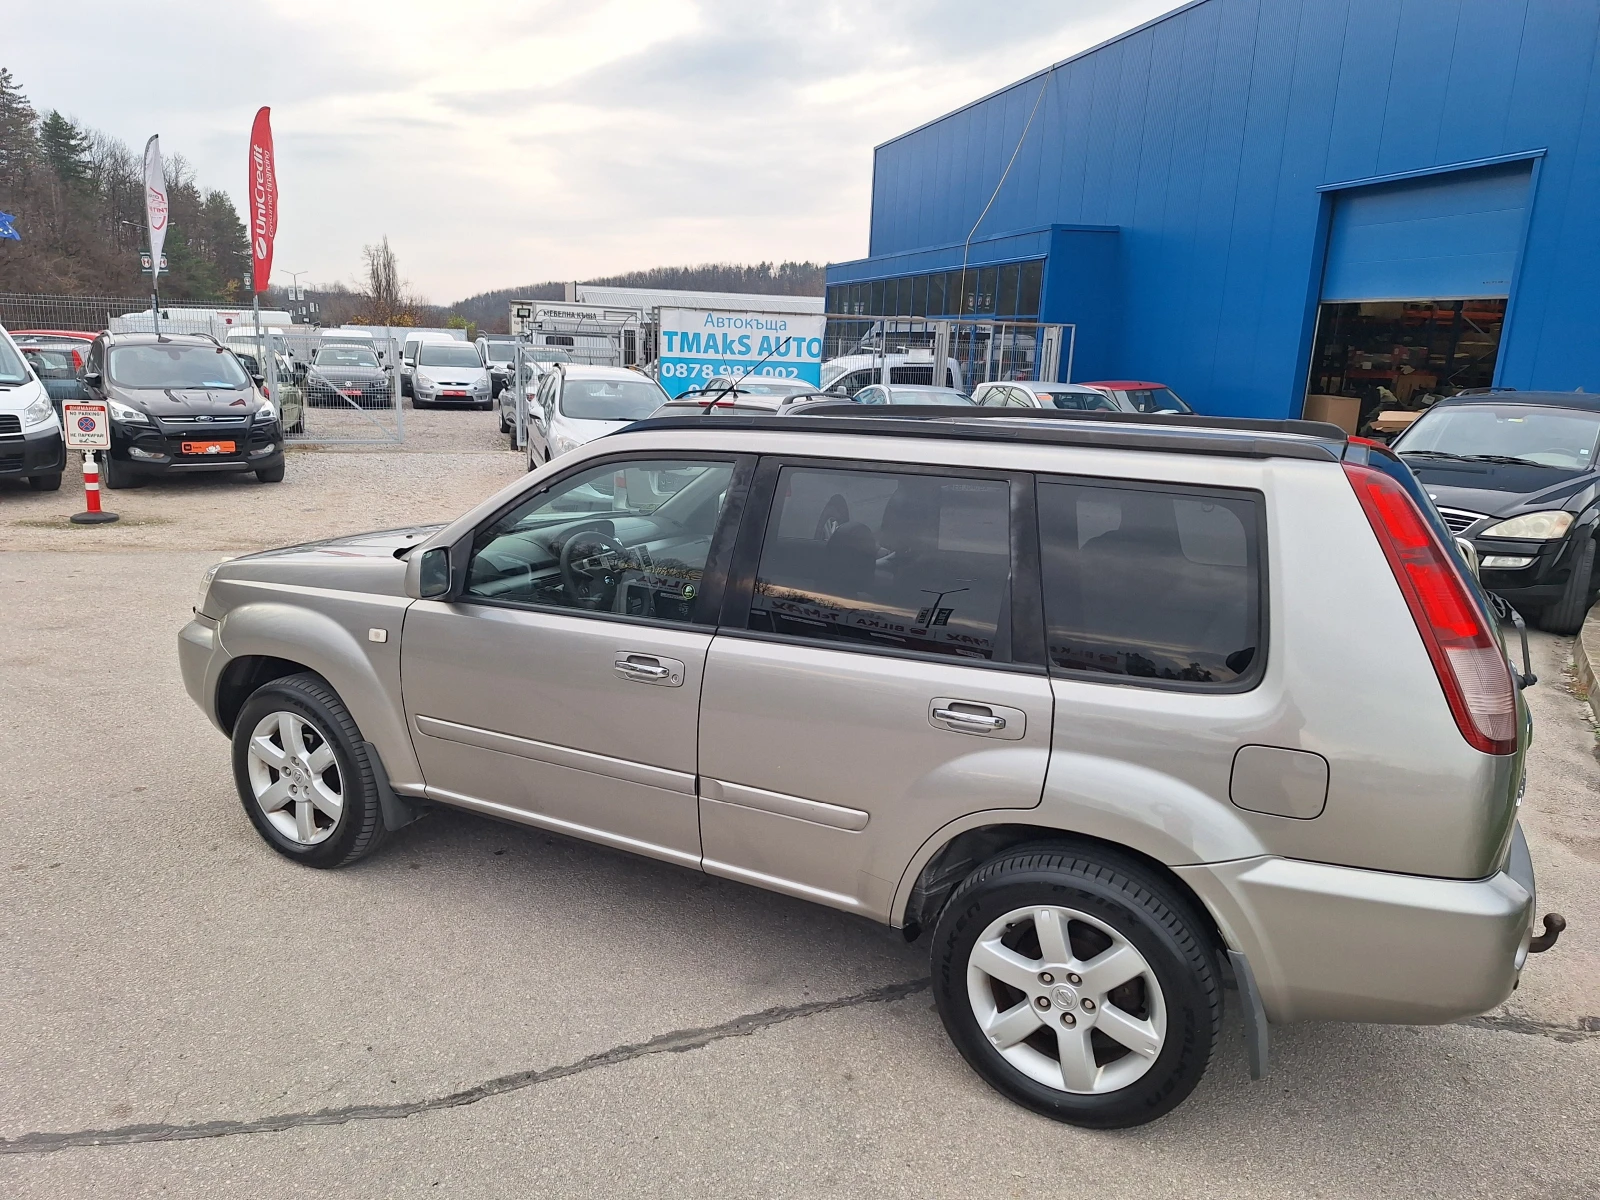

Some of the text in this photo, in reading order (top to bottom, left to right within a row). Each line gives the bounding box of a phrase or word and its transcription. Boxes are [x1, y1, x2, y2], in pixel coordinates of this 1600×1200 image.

[264, 150, 272, 192] Financing
[253, 143, 266, 235] UniCredit
[704, 312, 787, 333] Автокъща
[662, 330, 822, 358] TMAkS AUTO
[661, 362, 714, 378] 0878
